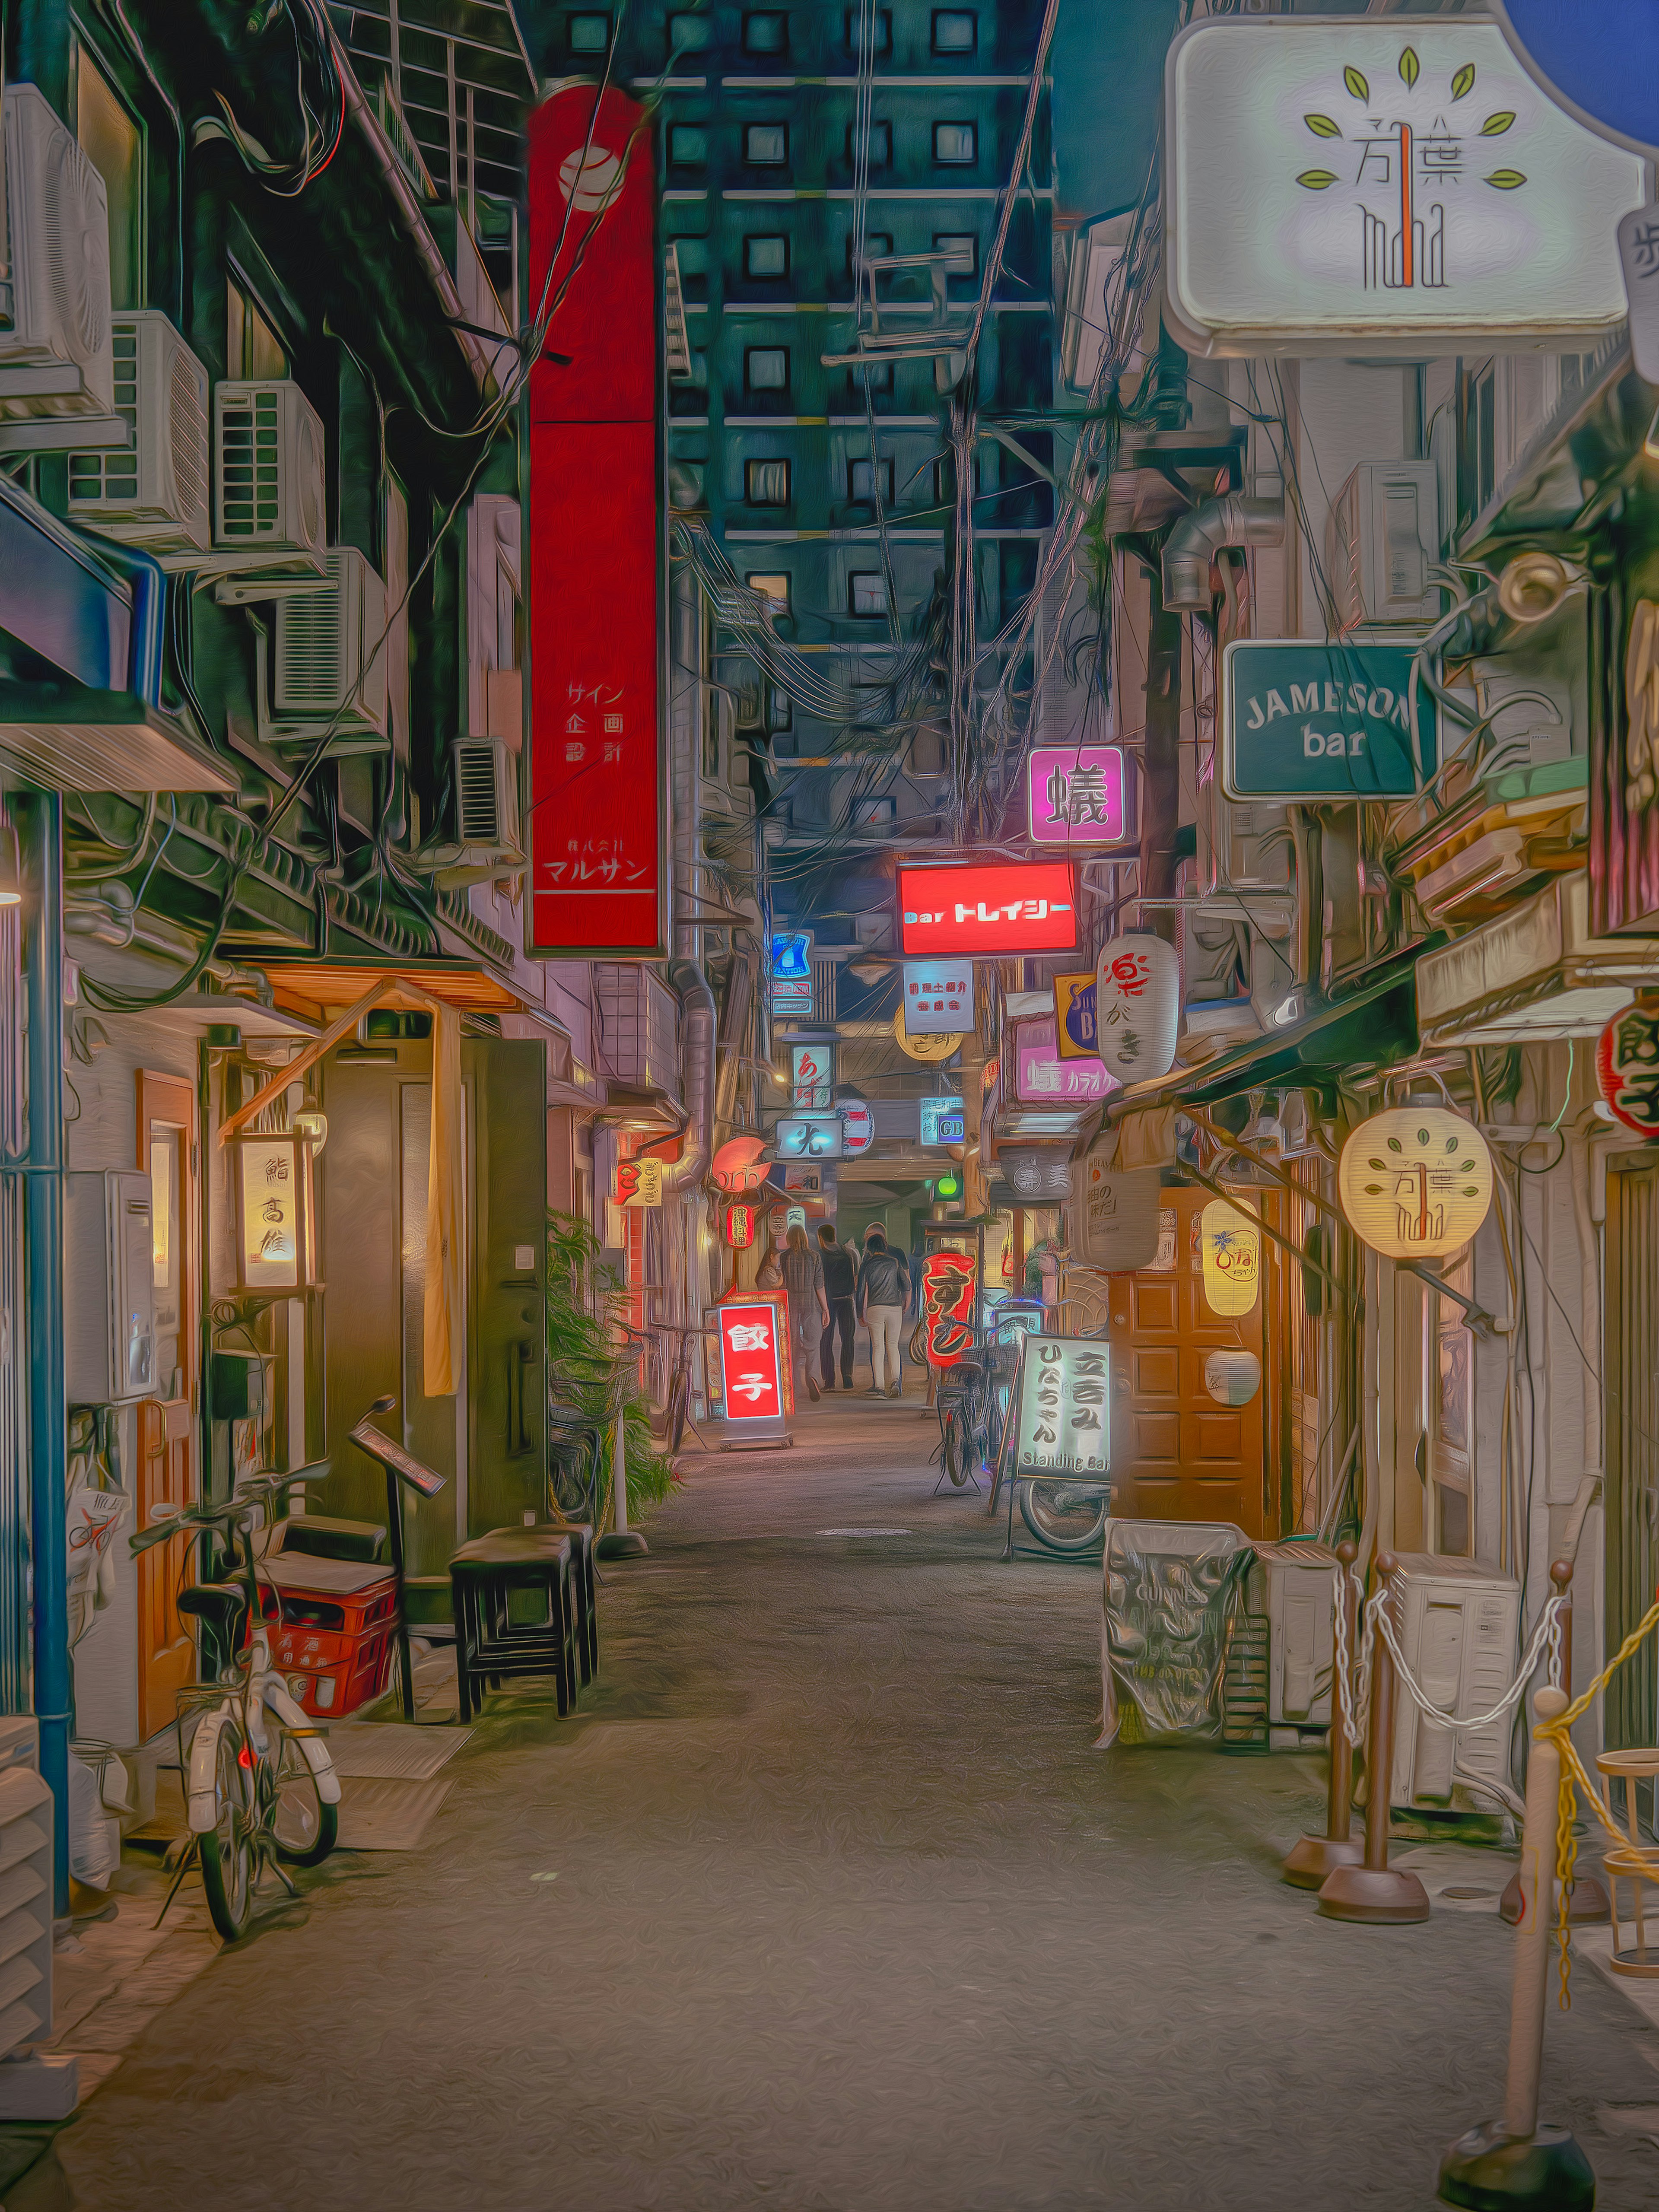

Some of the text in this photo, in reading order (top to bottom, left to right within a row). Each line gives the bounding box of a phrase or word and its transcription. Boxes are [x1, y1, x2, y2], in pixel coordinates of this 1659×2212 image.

[566, 683, 625, 705] サイン
[566, 713, 623, 734] 企画
[1300, 724, 1367, 758] bar
[542, 858, 648, 884] マルサン
[904, 899, 1071, 924] Bar トレイシー
[773, 937, 805, 946] AWON
[941, 1120, 963, 1136] GB
[715, 1163, 760, 1191] orb
[732, 1207, 747, 1246] 沖縄料理
[727, 1322, 772, 1402] 餃子
[1032, 1344, 1062, 1444] ひなちゃん
[1023, 1451, 1110, 1472] Standing Bar
[1136, 1583, 1210, 1604] GUINNESS
